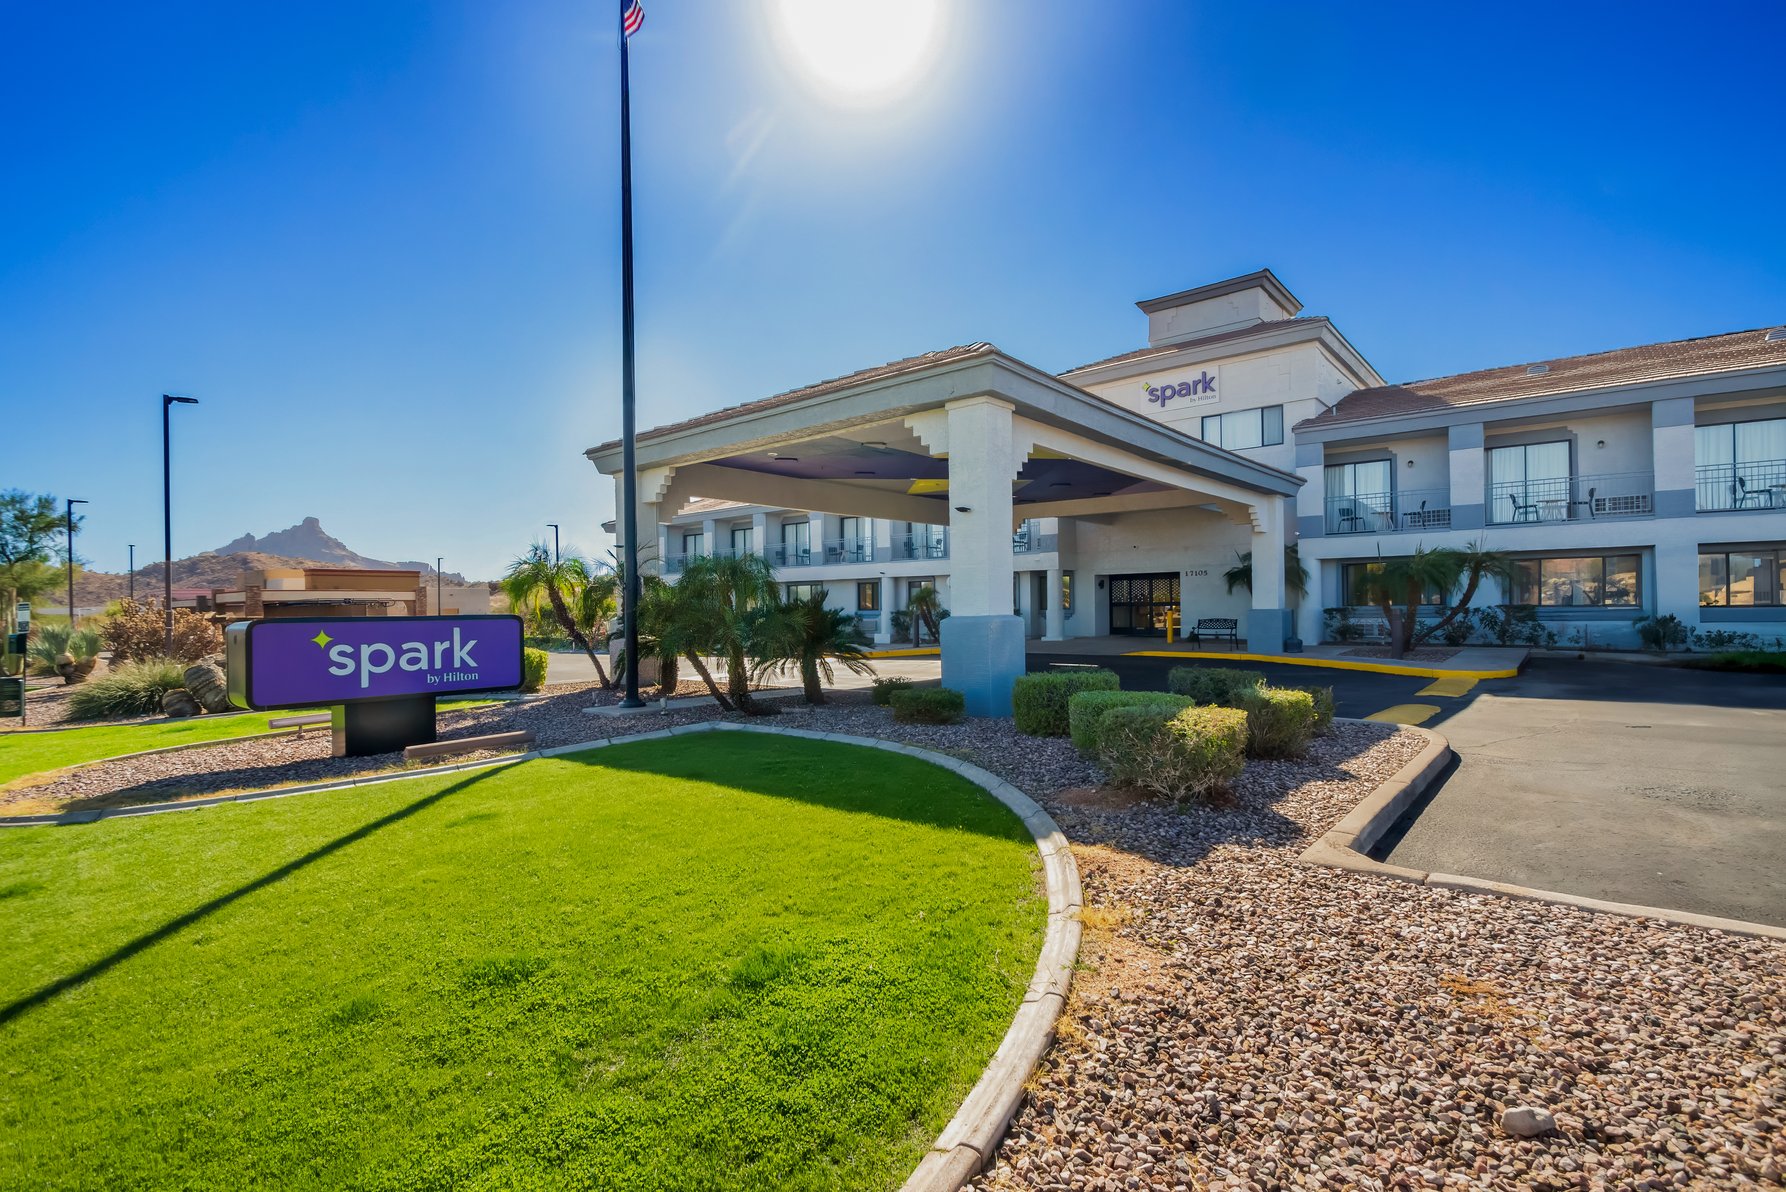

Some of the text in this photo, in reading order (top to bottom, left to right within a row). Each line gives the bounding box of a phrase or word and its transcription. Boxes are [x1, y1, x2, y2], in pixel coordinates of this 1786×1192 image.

[1148, 371, 1216, 407] spark
[1197, 394, 1216, 402] Hilton
[328, 627, 478, 688] spark
[427, 671, 479, 685] by Hilton
